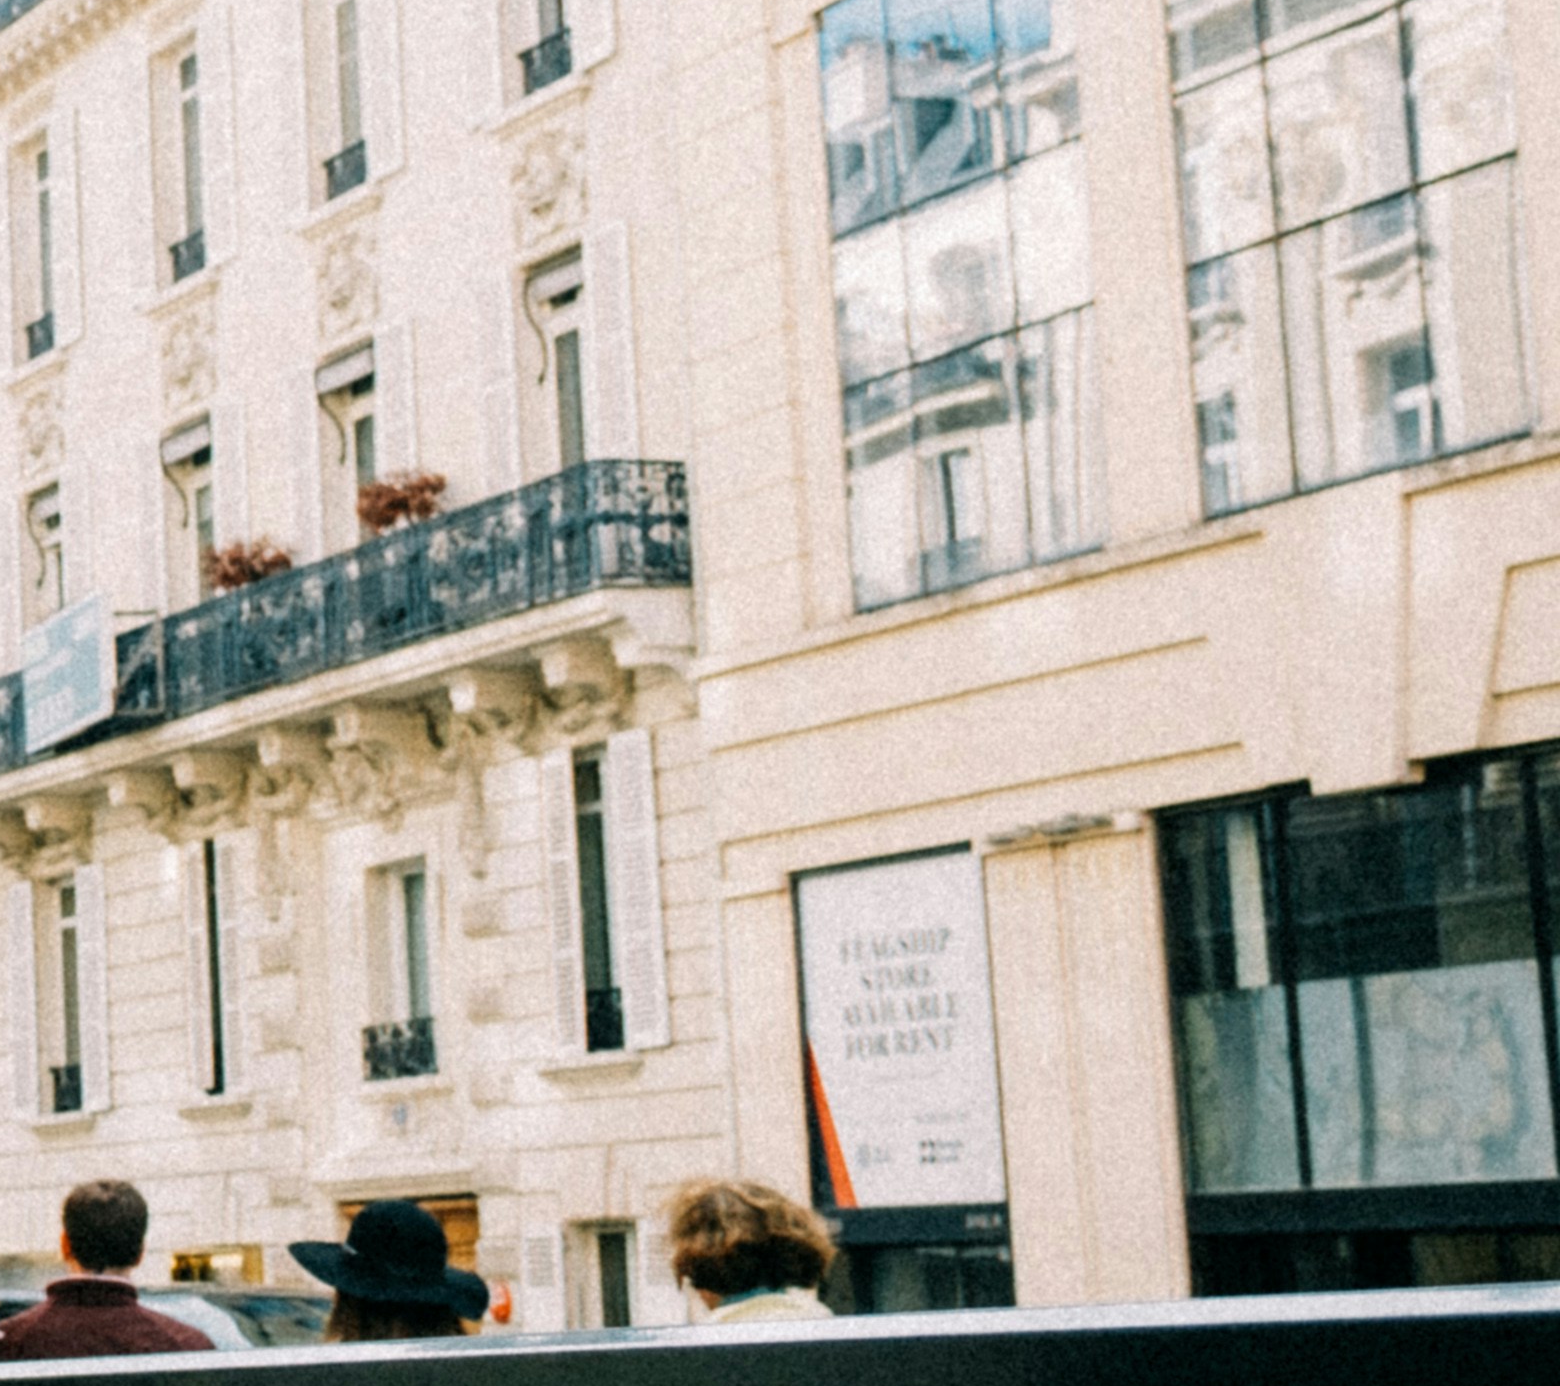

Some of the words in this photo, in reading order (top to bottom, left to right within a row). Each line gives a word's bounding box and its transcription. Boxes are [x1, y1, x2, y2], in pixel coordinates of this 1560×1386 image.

[861, 964, 938, 994] STORE
[844, 1032, 890, 1061] FOR
[893, 1024, 956, 1055] RENT
